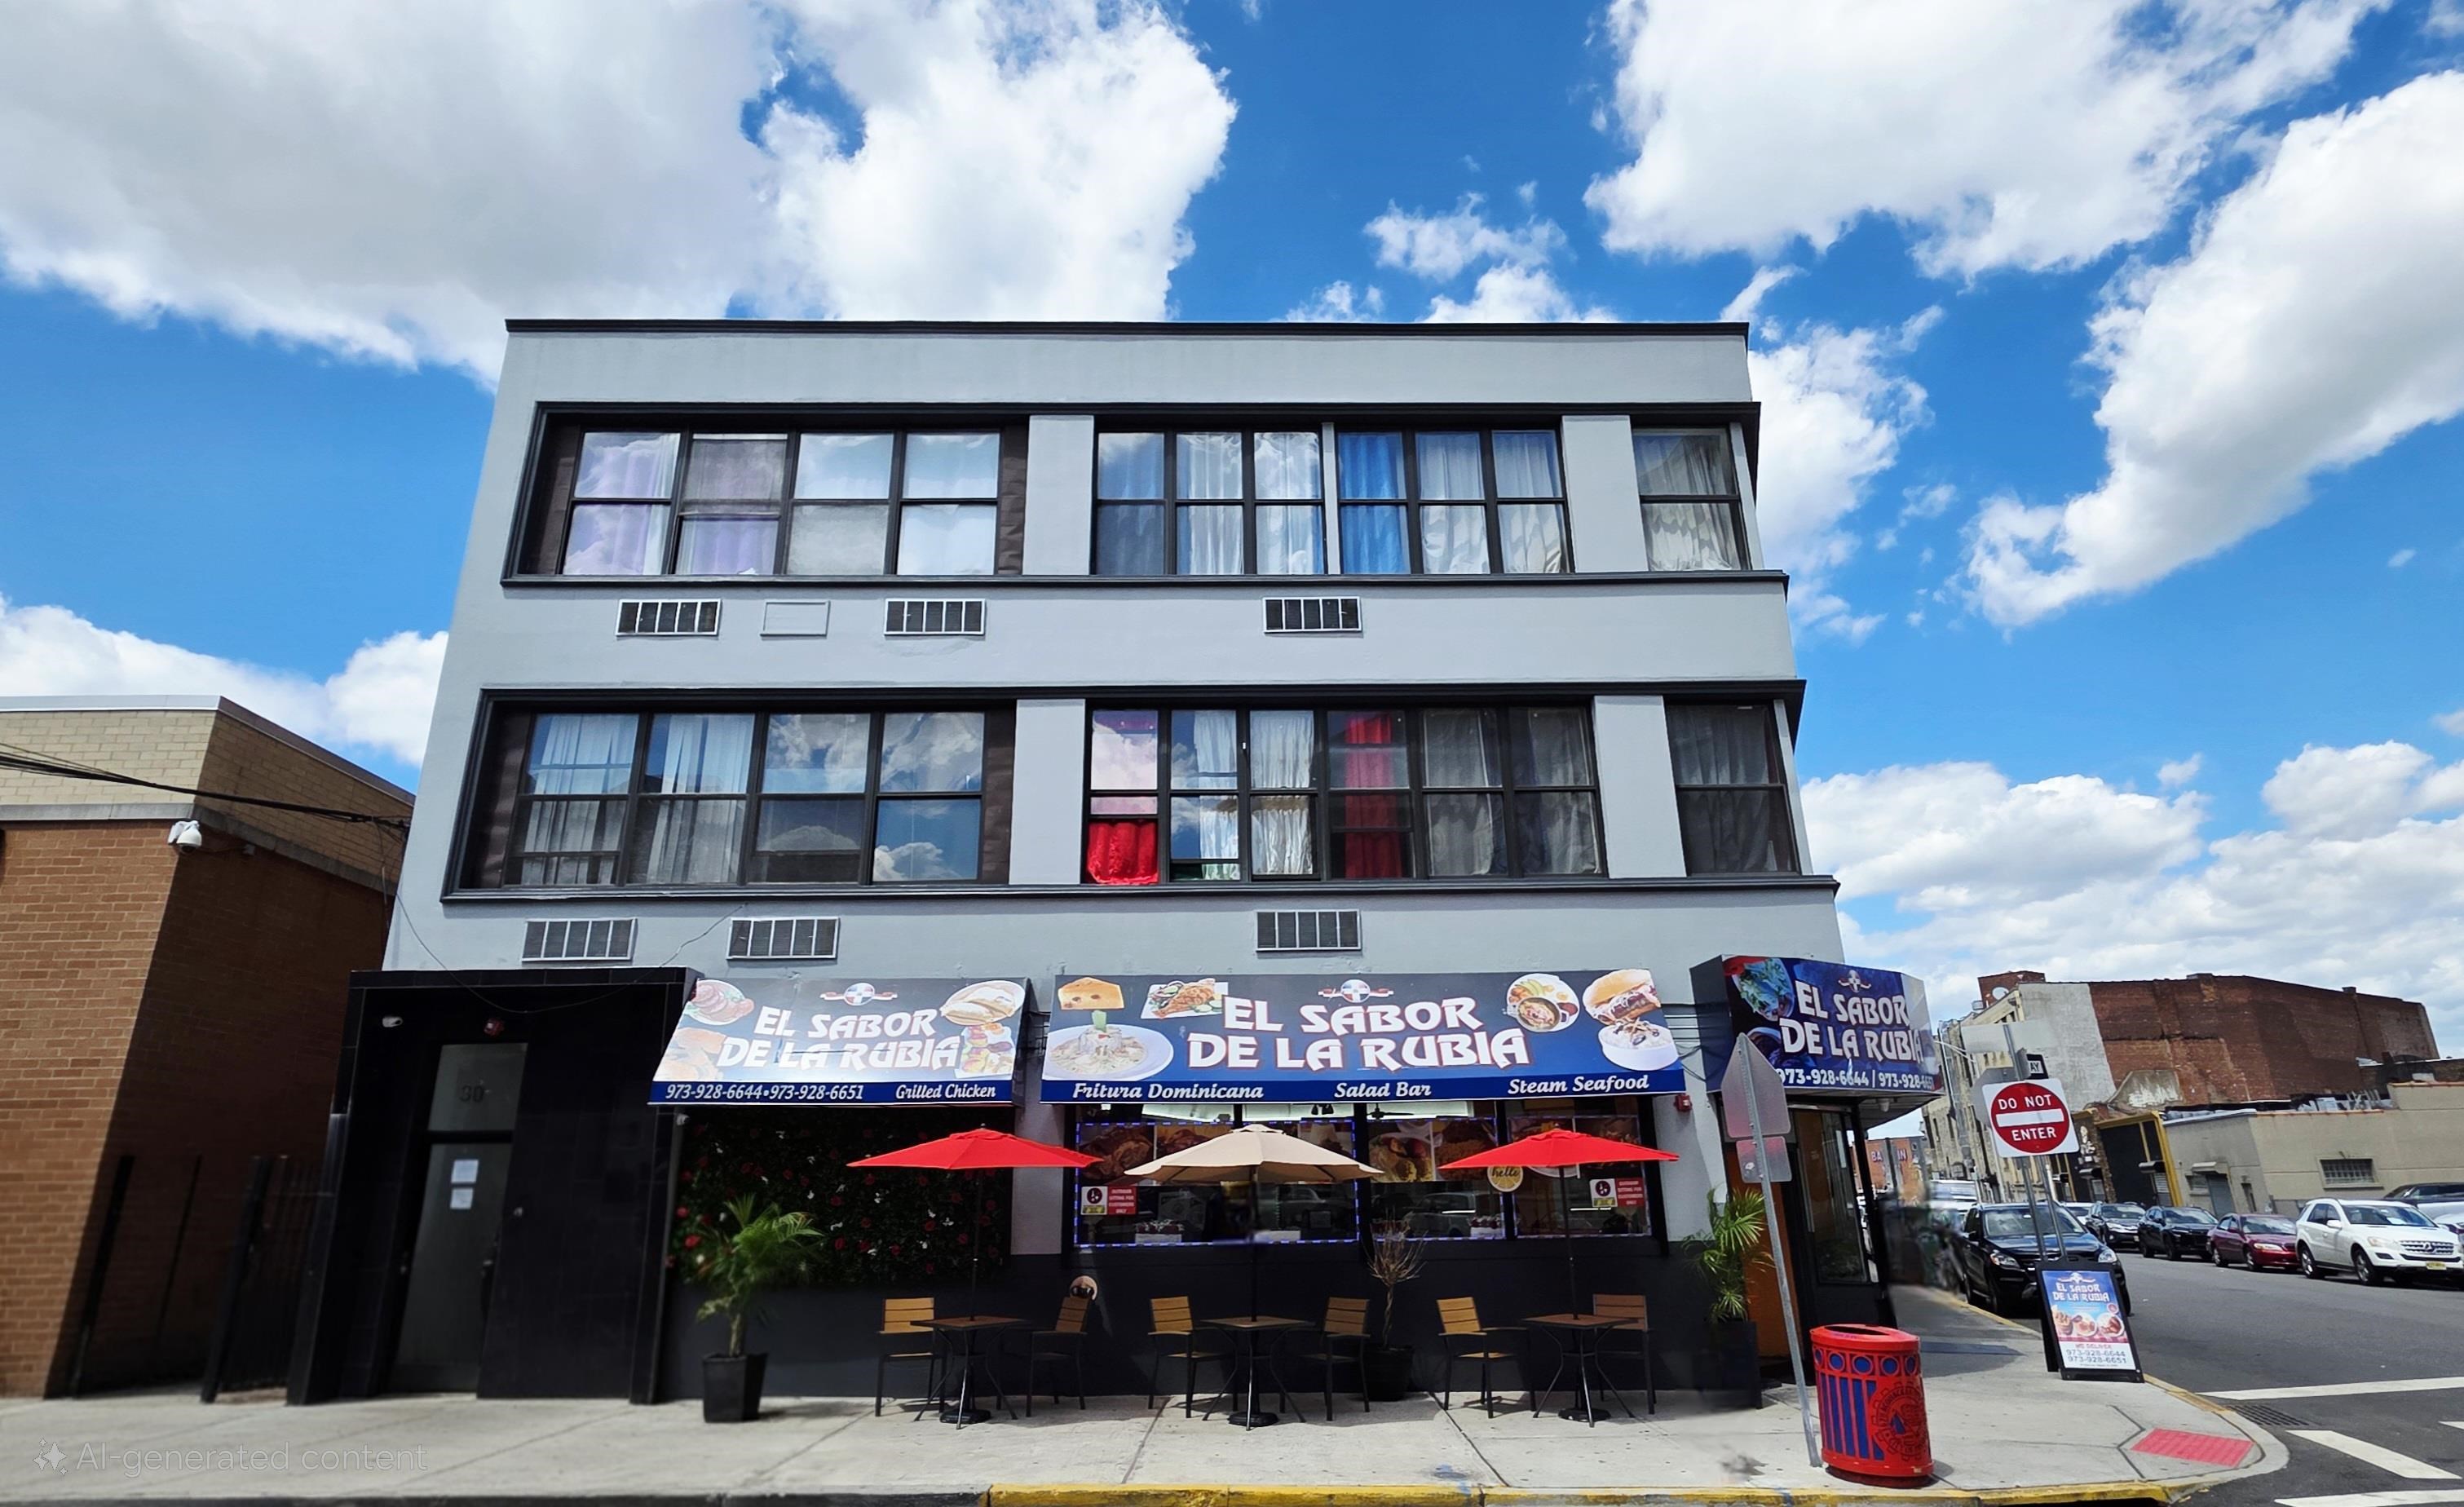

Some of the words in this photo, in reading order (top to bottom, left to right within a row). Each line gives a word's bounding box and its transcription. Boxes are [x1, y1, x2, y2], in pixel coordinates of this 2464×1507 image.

[1794, 980, 1829, 1019] EL
[1833, 993, 1910, 1028] SABOR
[753, 1005, 795, 1036] EL
[808, 1008, 938, 1041] SABOR
[1225, 996, 1284, 1032] EL
[1300, 997, 1483, 1036] SABOR
[1779, 1018, 1825, 1056] DE
[1826, 1026, 1860, 1061] LA
[1863, 1029, 1925, 1064] RUBIA
[716, 1037, 770, 1069] DE
[778, 1043, 831, 1071] LA
[838, 1036, 961, 1072] RUBIA
[1188, 1032, 1260, 1068] DE
[1276, 1038, 1343, 1072] LA
[1359, 1028, 1530, 1073] RUBIA
[2030, 1063, 2039, 1072] AY
[895, 1083, 943, 1100] Grilled
[945, 1082, 996, 1098] Chicken
[1072, 1082, 1143, 1099] Fritura
[1148, 1083, 1265, 1099] Dominicana
[1334, 1082, 1391, 1098] Salad
[1395, 1081, 1432, 1098] Bar
[1508, 1078, 1570, 1095] Steam
[1573, 1074, 1649, 1094] Seafood
[1998, 1097, 2018, 1111] DO
[2025, 1094, 2052, 1108] NOT
[2011, 1126, 2057, 1142] ENTER
[2052, 1292, 2066, 1301] DE
[2067, 1293, 2079, 1302] LA
[2056, 1283, 2068, 1293] EL
[2069, 1284, 2101, 1293] SABOR
